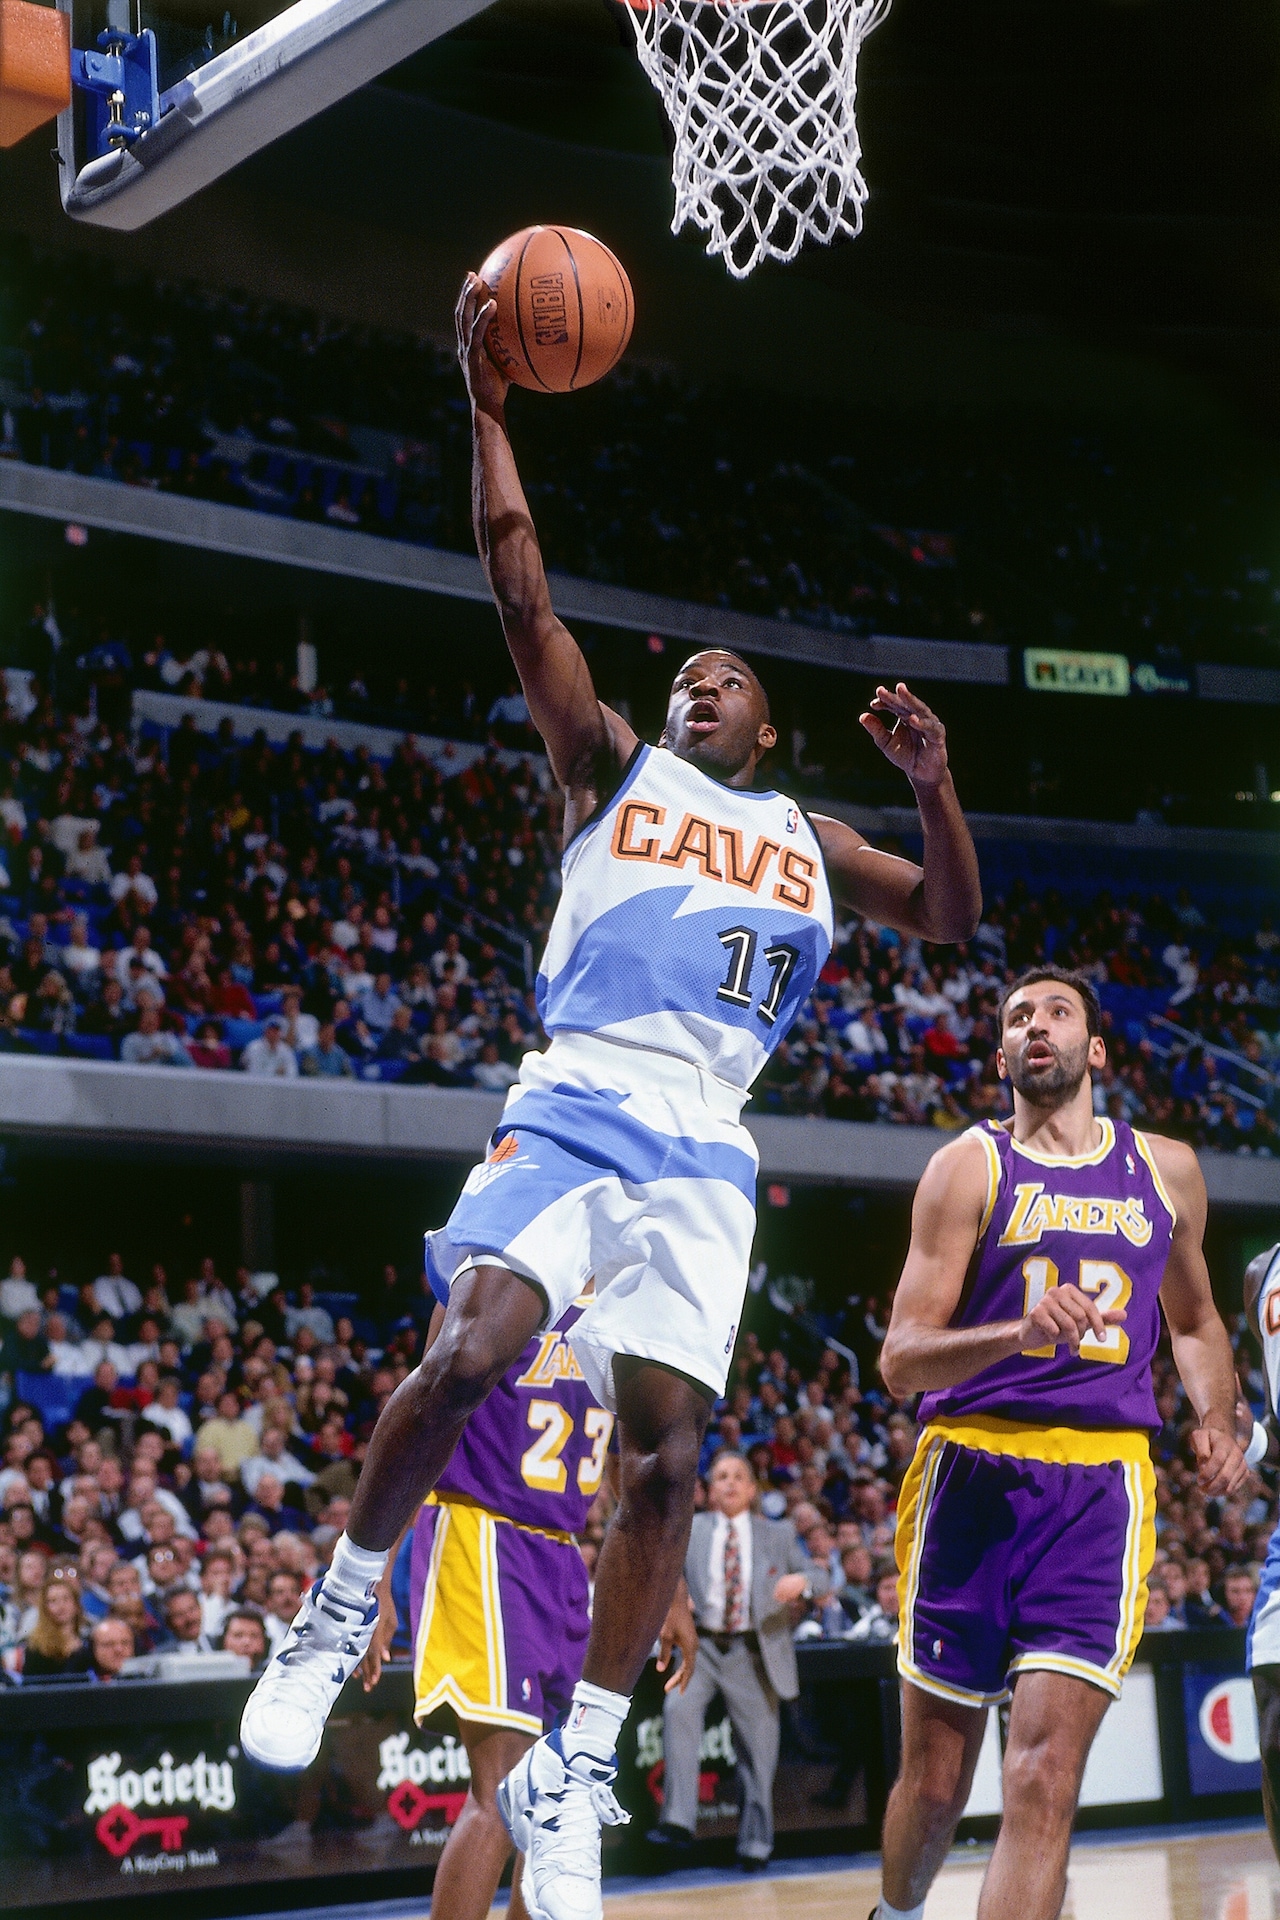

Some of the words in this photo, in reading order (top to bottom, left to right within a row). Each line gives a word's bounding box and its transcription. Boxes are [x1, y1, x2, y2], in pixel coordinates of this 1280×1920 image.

[530, 272, 567, 331] NBA
[610, 799, 818, 914] CAVS
[716, 924, 800, 1028] 11
[997, 1183, 1153, 1248] LAKERS
[1021, 1256, 1133, 1366] 12
[521, 1398, 614, 1496] 23
[84, 1751, 236, 1815] Society
[376, 1732, 472, 1790] Socie
